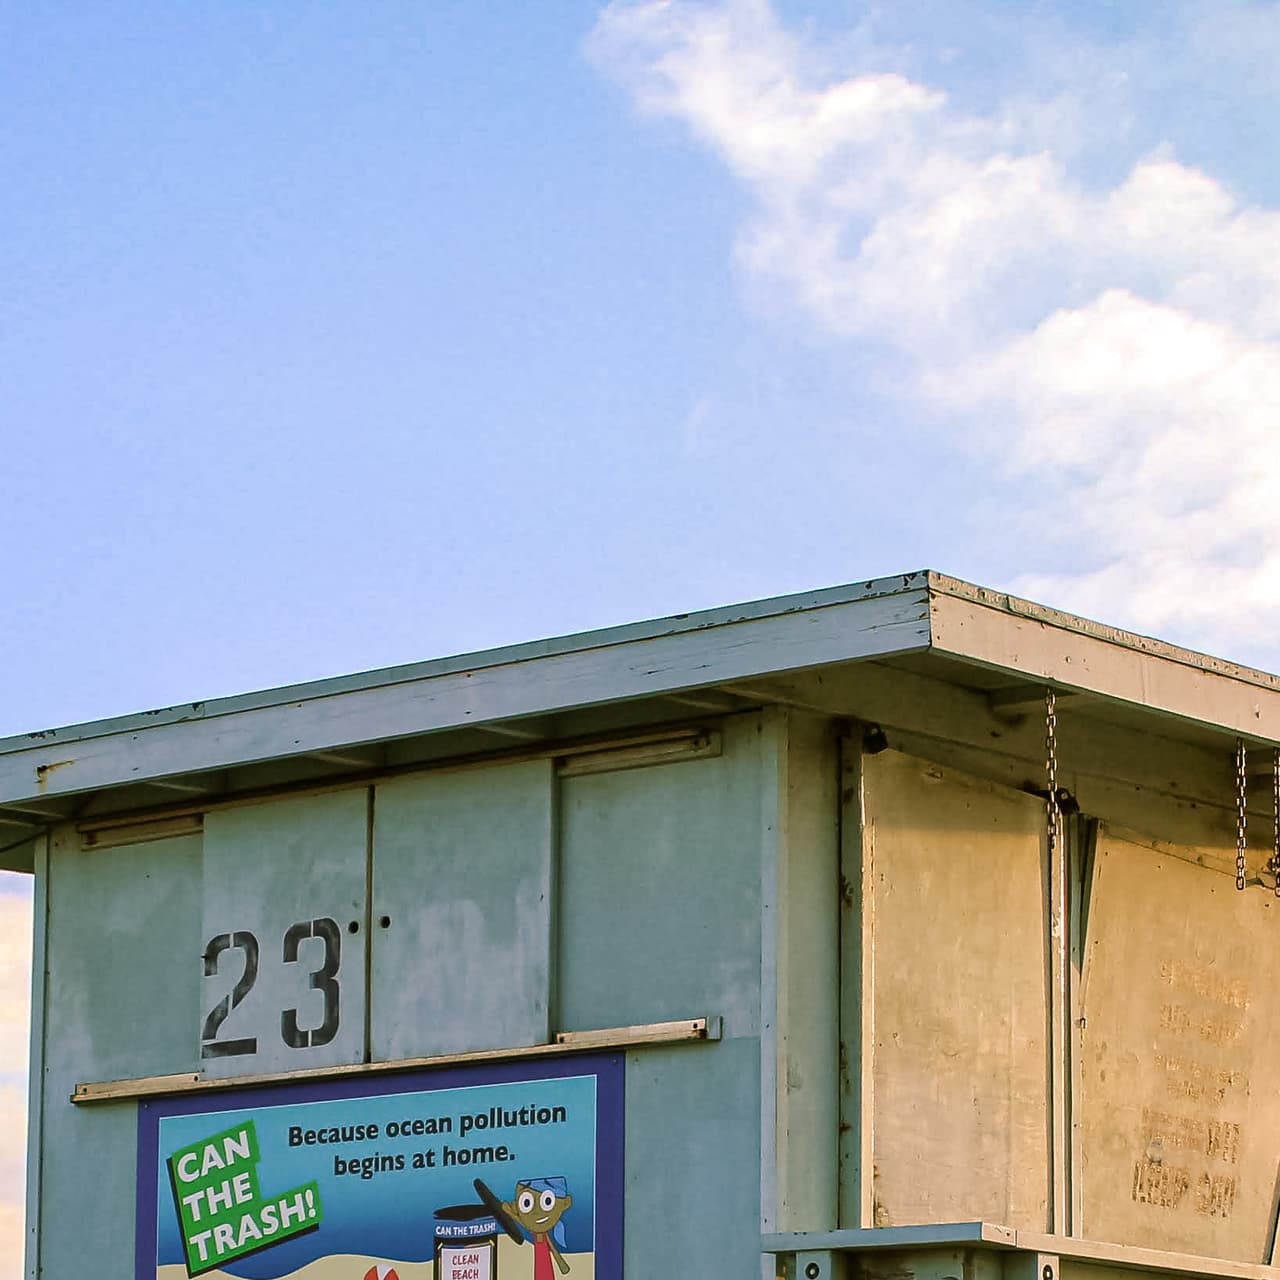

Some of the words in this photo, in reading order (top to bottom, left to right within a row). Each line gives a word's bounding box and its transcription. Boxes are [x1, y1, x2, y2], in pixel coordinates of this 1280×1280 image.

[201, 917, 341, 1059] 23
[288, 1123, 378, 1147] Because
[386, 1116, 452, 1137] ocean
[460, 1104, 567, 1137] pollution
[177, 1130, 251, 1183] CAN
[334, 1152, 405, 1179] begins
[412, 1151, 435, 1169] at
[443, 1145, 515, 1166] home.
[182, 1172, 253, 1222] THE
[189, 1189, 316, 1261] TRASH!
[435, 1226, 451, 1235] CAN
[453, 1225, 468, 1235] THE
[470, 1222, 496, 1234] TRASH!
[452, 1254, 479, 1266] CLEAN
[452, 1269, 479, 1280] BEACH
